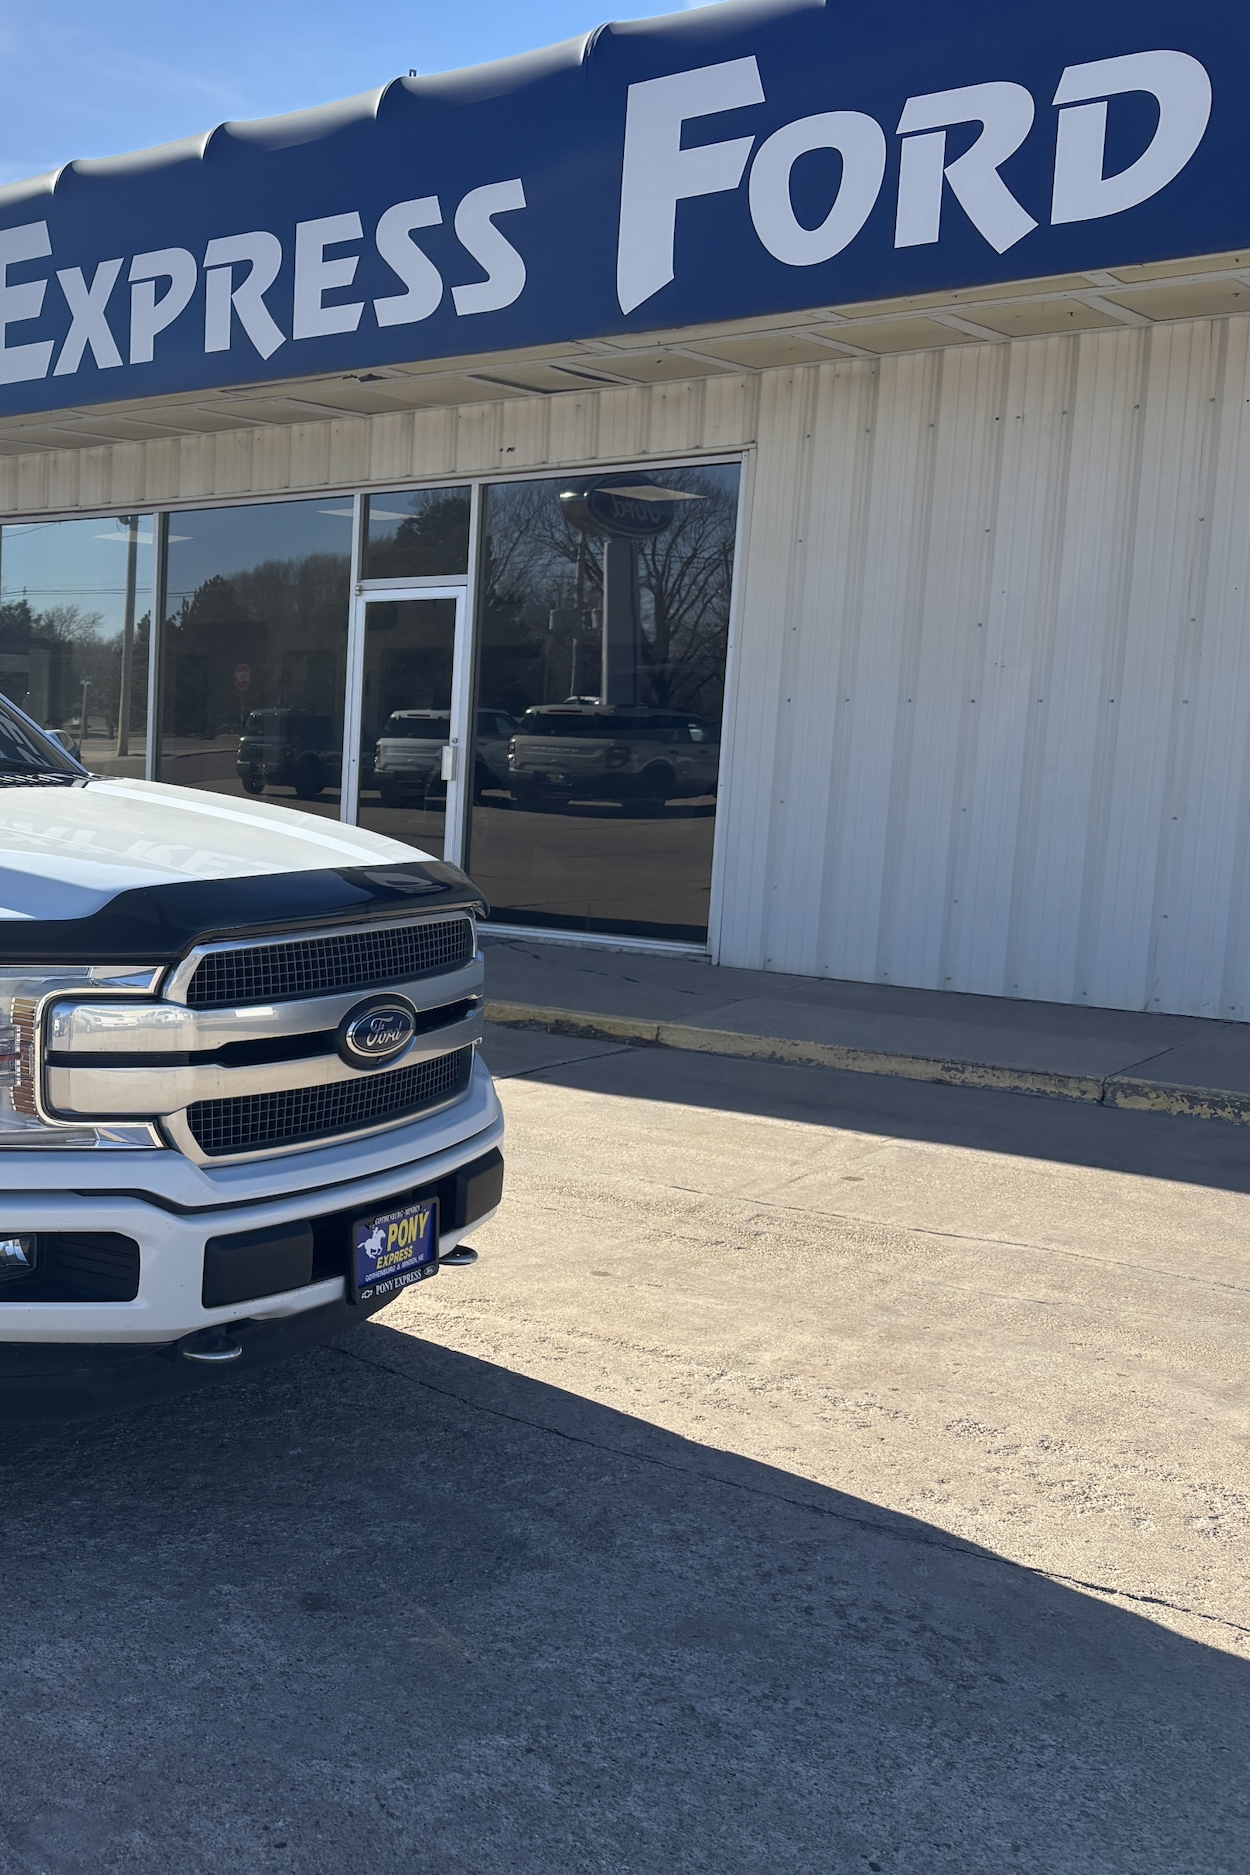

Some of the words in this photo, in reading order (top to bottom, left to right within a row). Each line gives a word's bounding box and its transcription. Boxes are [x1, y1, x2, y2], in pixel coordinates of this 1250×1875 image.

[617, 49, 1212, 316] FORD
[366, 1016, 403, 1047] Ford
[387, 1210, 430, 1251] PONY
[376, 1245, 414, 1270] EXPRESS
[375, 1278, 394, 1296] PONY
[394, 1269, 422, 1287] EXPRESS
